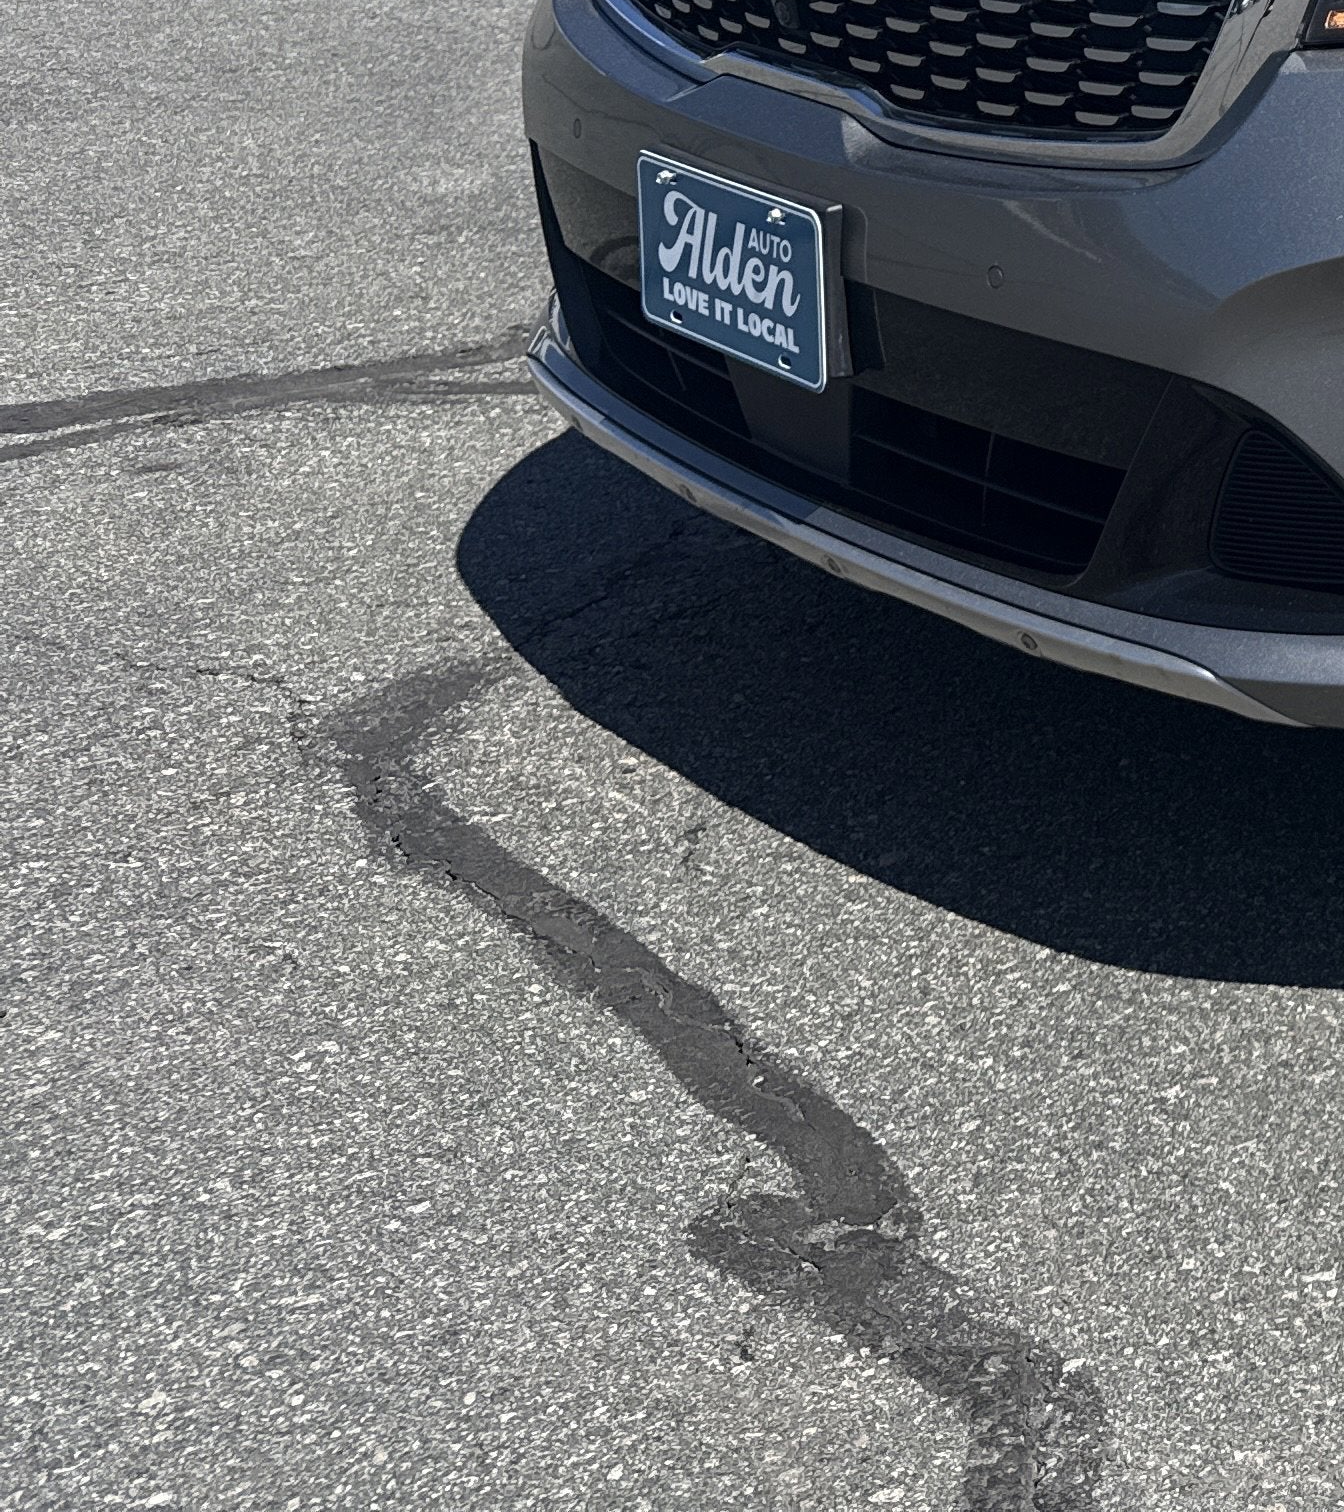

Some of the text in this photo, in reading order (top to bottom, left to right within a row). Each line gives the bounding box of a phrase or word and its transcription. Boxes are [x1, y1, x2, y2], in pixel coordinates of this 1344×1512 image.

[658, 190, 801, 317] Alden
[747, 227, 792, 263] AUTO
[662, 276, 800, 354] LOVE IT LOCAL
